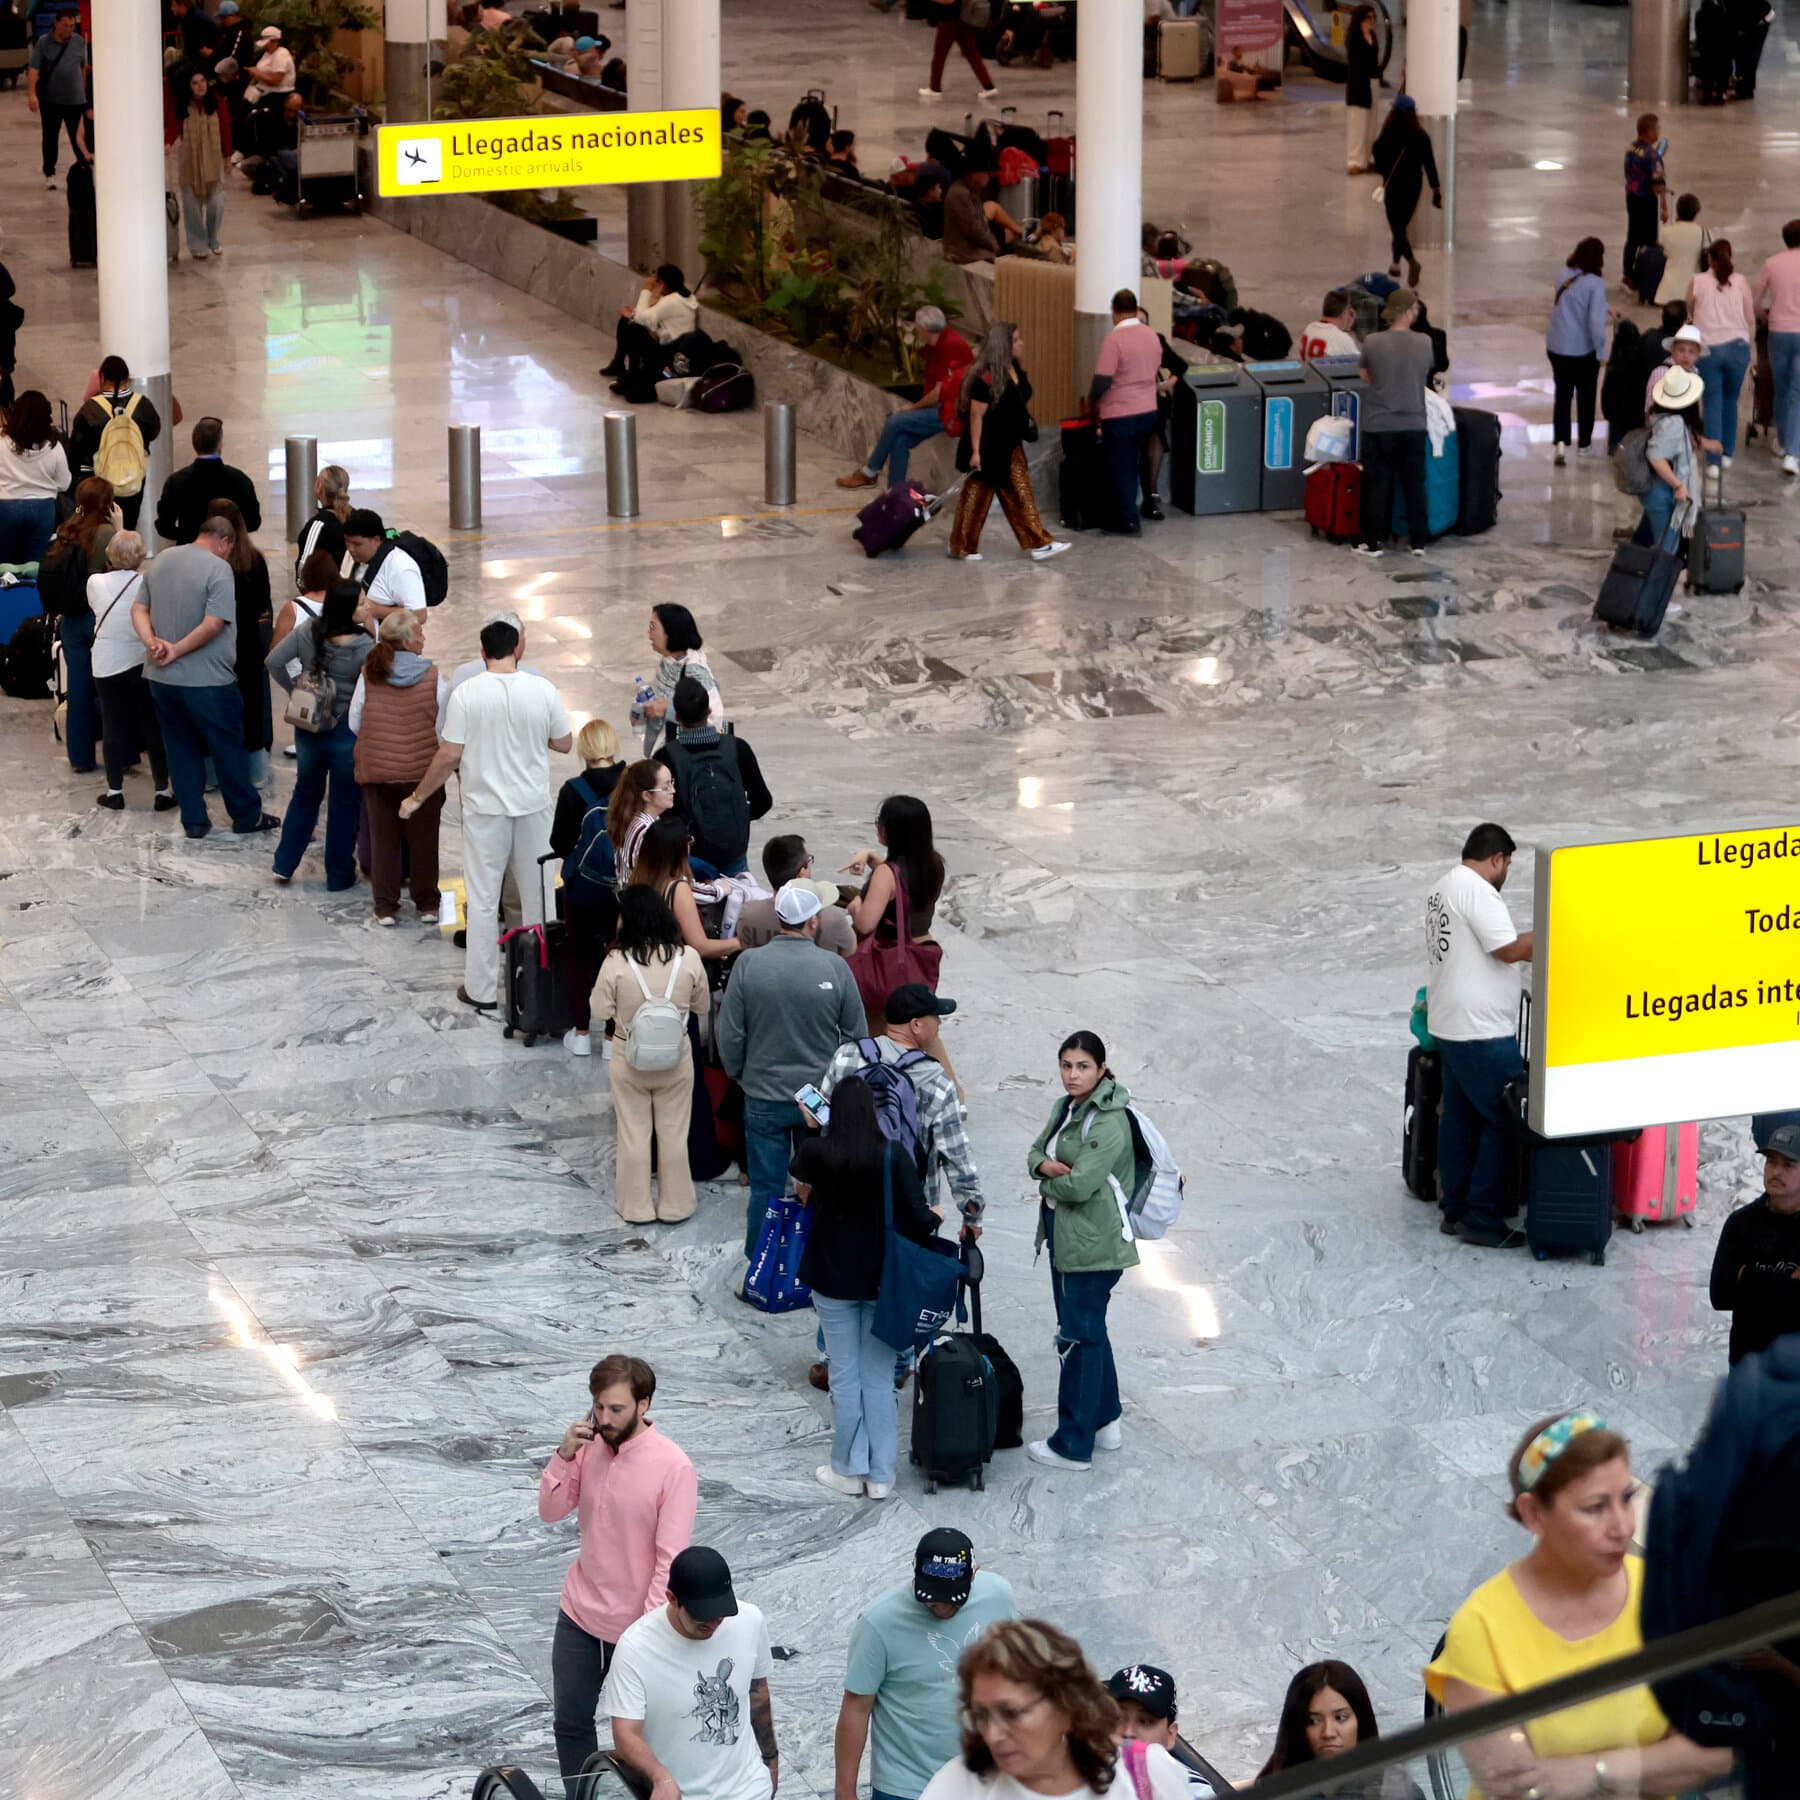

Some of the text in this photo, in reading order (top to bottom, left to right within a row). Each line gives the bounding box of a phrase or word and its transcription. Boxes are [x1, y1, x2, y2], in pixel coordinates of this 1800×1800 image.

[452, 122, 704, 160] Llegadas nacionales
[452, 156, 583, 179] Domestic arrivals
[1698, 831, 1800, 869] Llegada
[1626, 983, 1748, 1022] Llegadas
